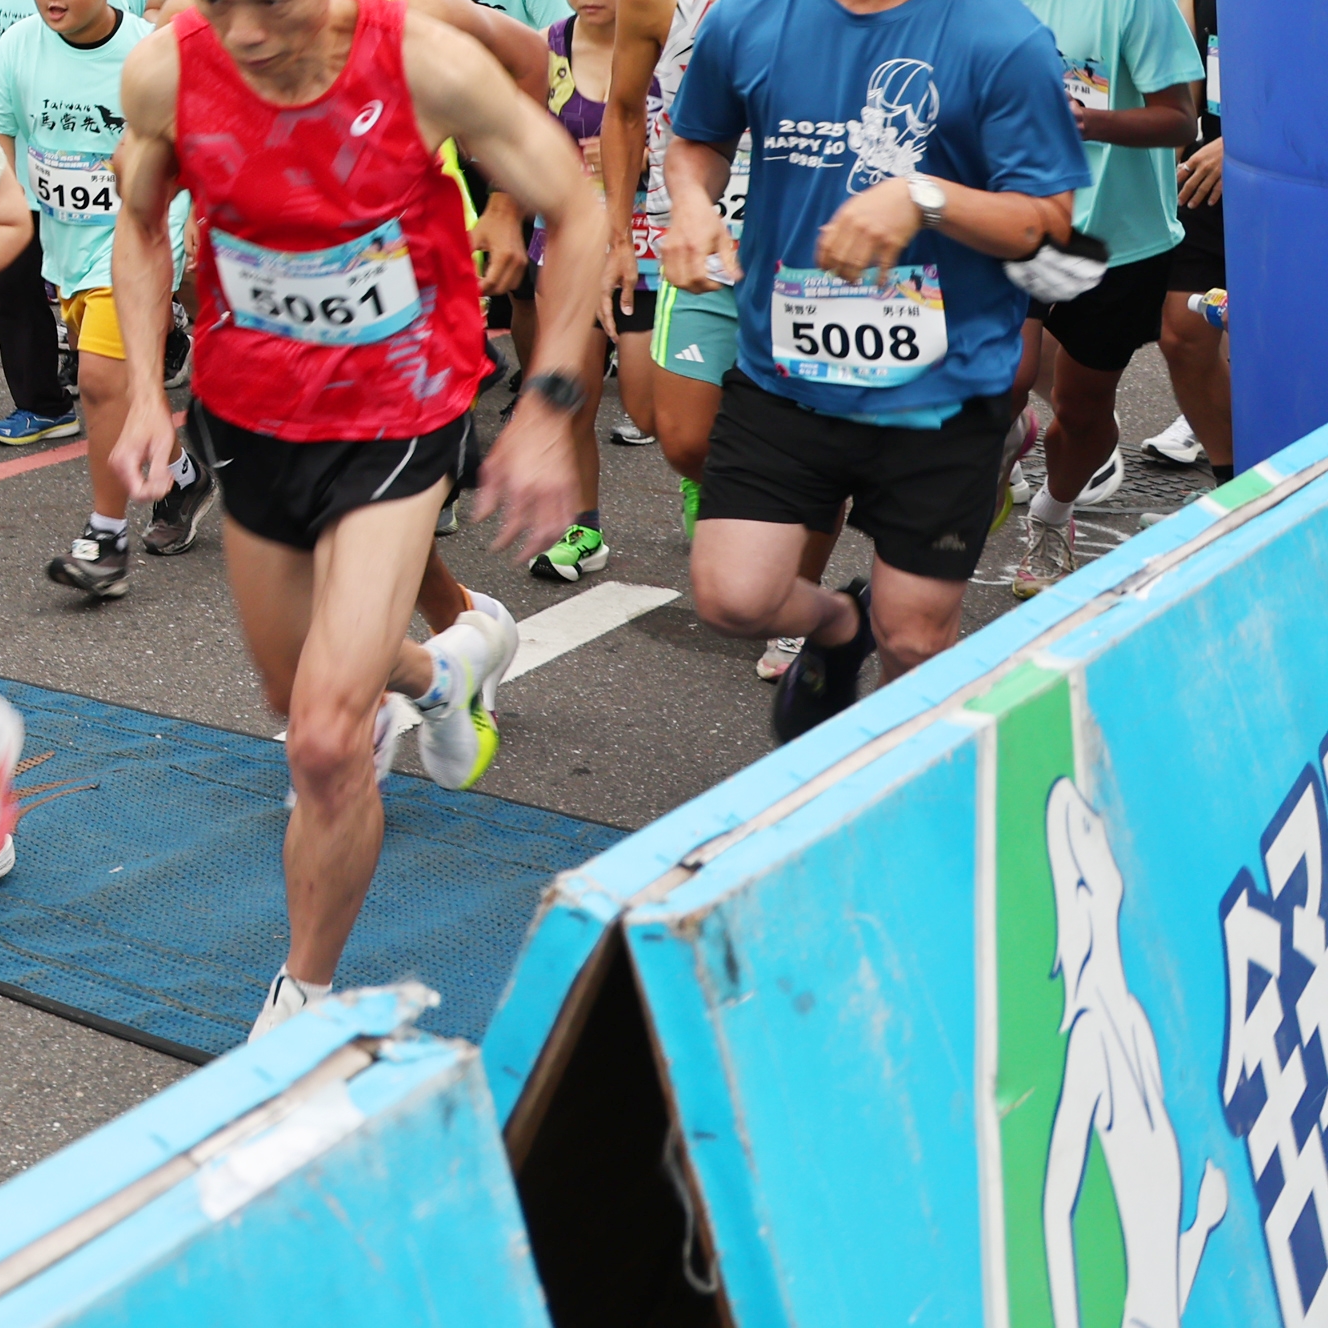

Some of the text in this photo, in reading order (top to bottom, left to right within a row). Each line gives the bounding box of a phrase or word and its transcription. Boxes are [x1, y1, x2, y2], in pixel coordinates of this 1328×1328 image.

[43, 100, 91, 112] Taiwan
[778, 119, 846, 138] 2025
[763, 135, 823, 153] HAPPY
[37, 176, 114, 212] 5194
[882, 305, 921, 318] 男子組
[792, 322, 920, 362] 5008
